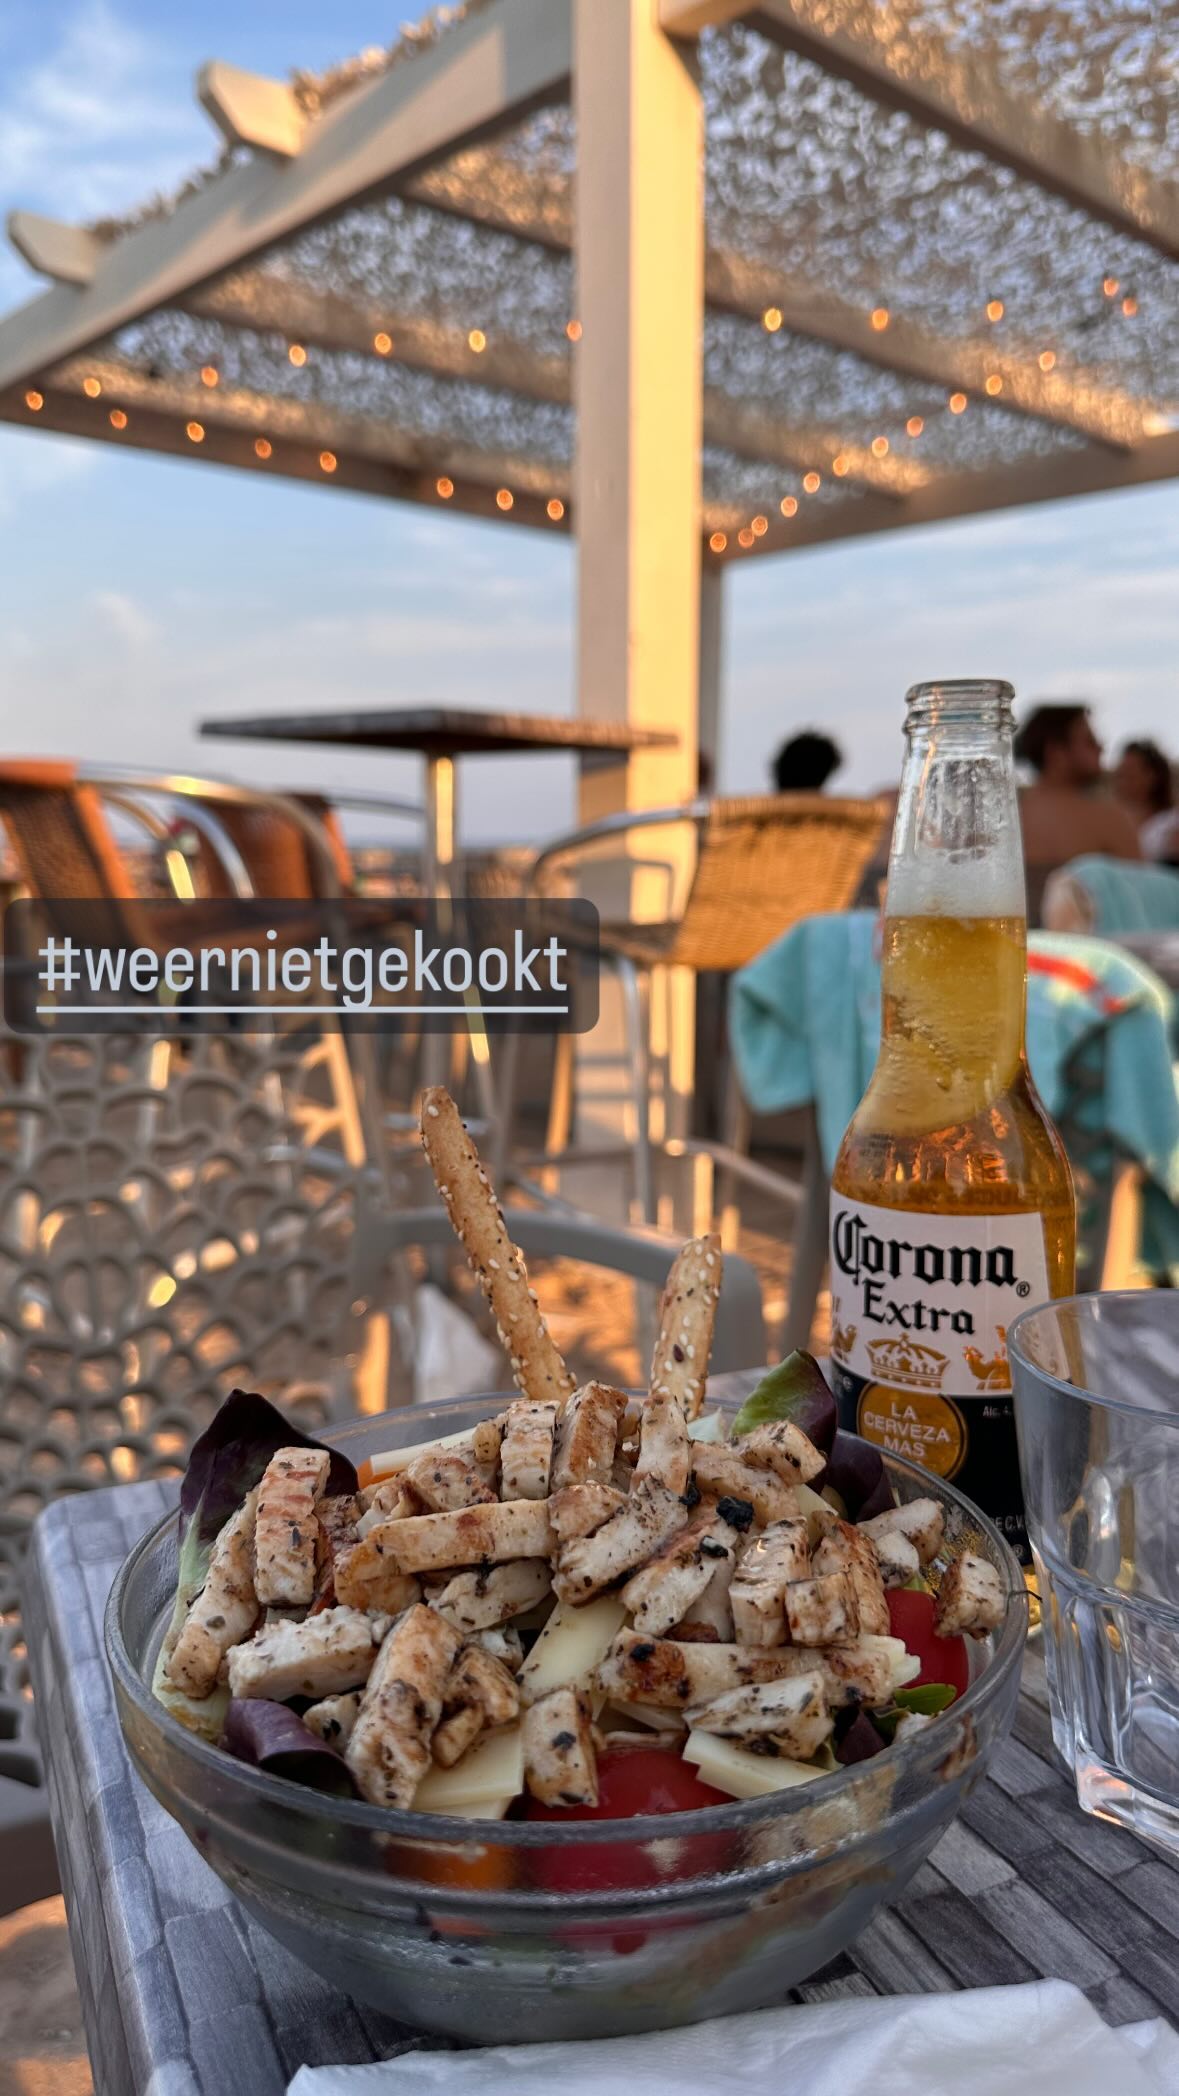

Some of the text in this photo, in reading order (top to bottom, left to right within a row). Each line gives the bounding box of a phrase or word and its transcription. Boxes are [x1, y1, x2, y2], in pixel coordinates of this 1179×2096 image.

[833, 1211, 1018, 1287] Corona
[862, 1278, 975, 1335] Extra
[863, 1410, 951, 1443] CERVEZA
[891, 1401, 918, 1421] LA
[883, 1434, 926, 1457] MAS
